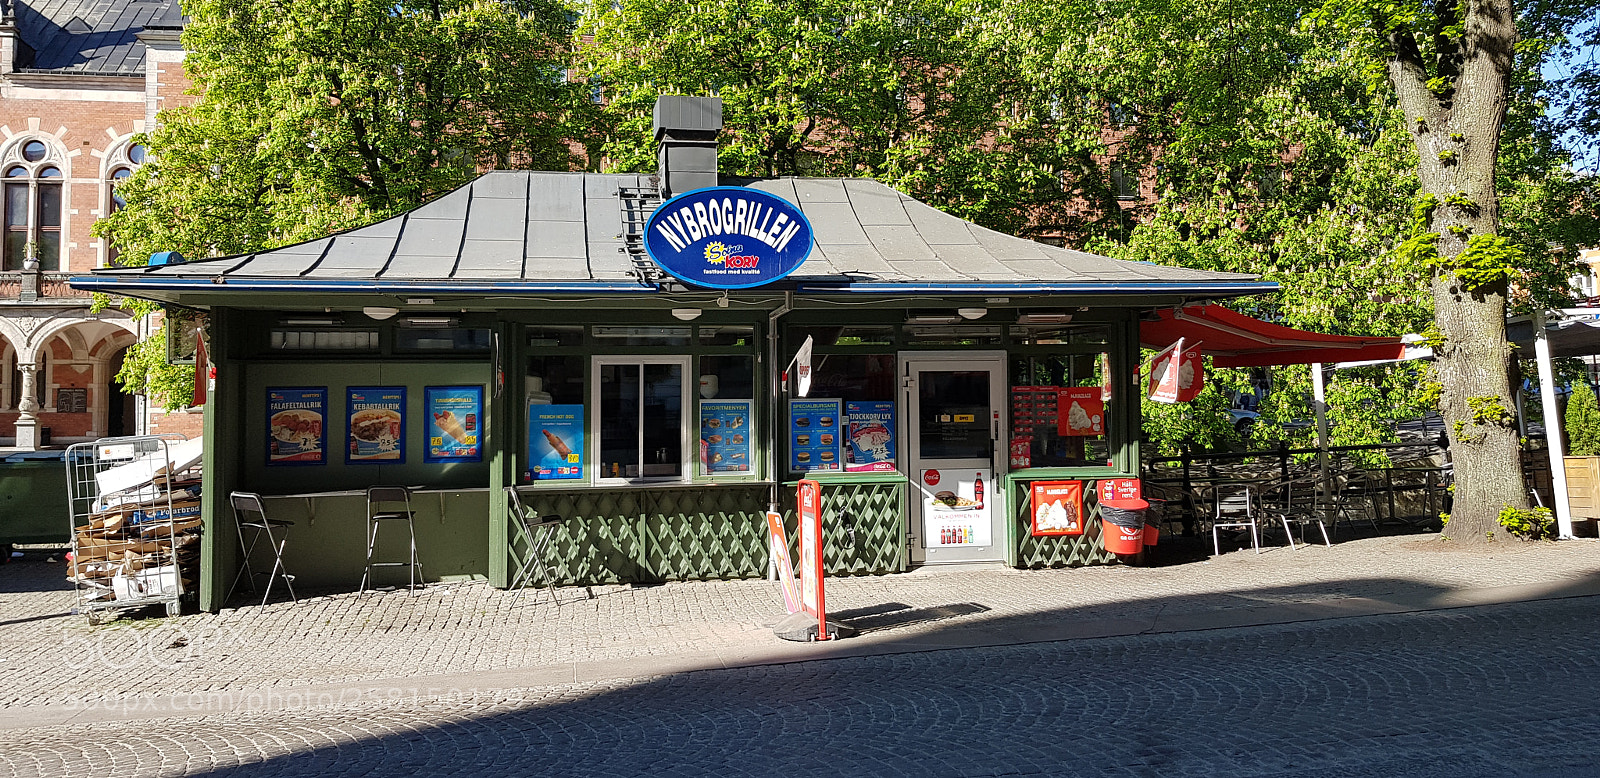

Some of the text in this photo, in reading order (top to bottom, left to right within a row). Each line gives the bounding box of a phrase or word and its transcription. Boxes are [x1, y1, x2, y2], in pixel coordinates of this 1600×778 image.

[655, 197, 801, 253] NYBROGRILLEN
[725, 255, 760, 269] KORV
[271, 401, 322, 410] FALAFELTALLRIK
